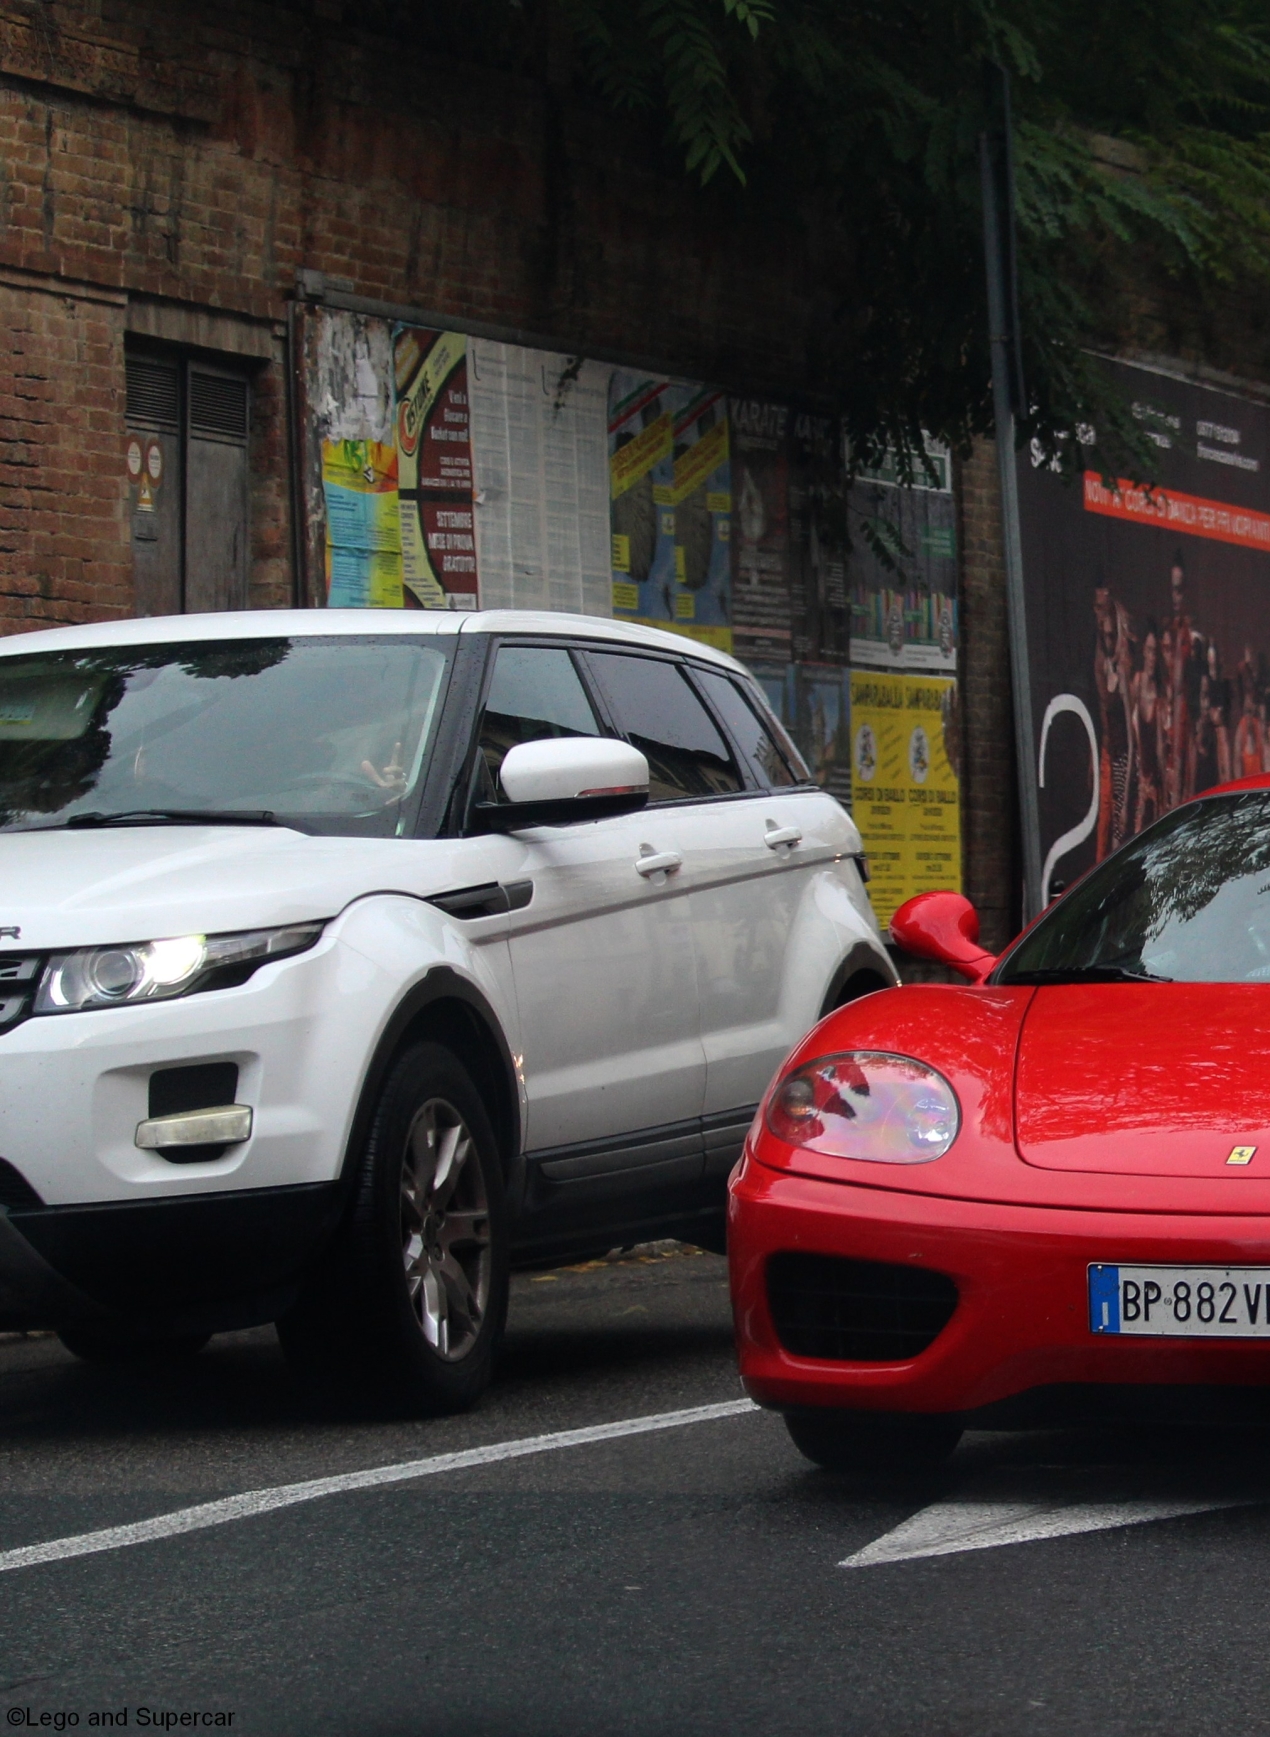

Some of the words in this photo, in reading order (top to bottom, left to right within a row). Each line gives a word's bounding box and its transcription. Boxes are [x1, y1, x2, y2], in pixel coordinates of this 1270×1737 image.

[730, 398, 788, 437] KARATE
[436, 510, 472, 528] SETTEMBRE
[427, 532, 446, 550] MESE
[453, 533, 474, 551] PROVA
